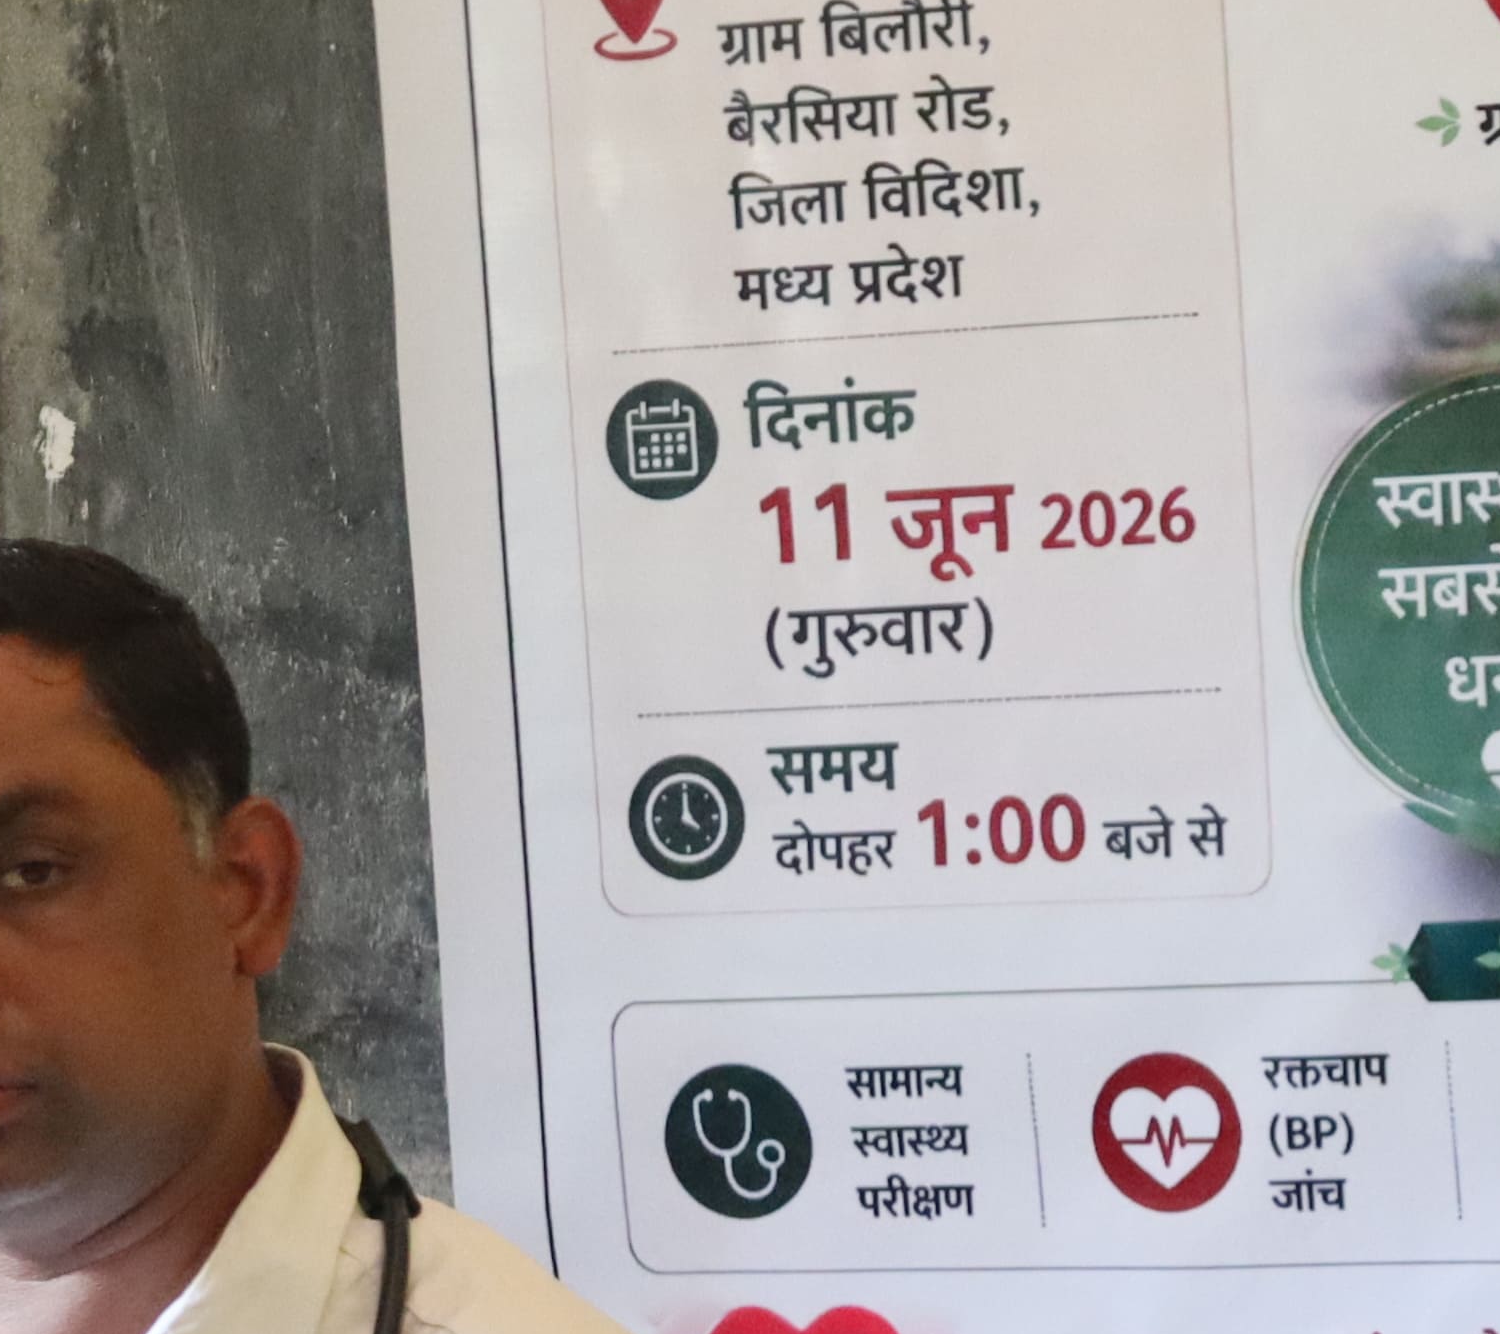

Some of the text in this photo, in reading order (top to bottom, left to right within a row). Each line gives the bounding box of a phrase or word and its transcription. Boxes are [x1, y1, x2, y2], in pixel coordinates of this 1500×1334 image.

[717, 19, 803, 65] ग्राम
[724, 74, 1009, 145] बैरसिया रोड,
[728, 158, 1039, 230] जिला विदिशा,
[734, 243, 964, 310] मध्य प्रदेश
[743, 377, 916, 450] दिनांक
[760, 484, 1195, 581] 11 जून 2026
[766, 597, 993, 678] (गुरुवार)
[766, 743, 898, 795] समय
[773, 794, 1227, 875] दोपहर 1:00 बजे से
[845, 1065, 962, 1099] सामान्य
[1262, 1054, 1389, 1088] रक्तचाप
[851, 1125, 968, 1157] स्वास्थ्य
[1270, 1113, 1354, 1157] (BP)
[857, 1174, 974, 1220] परीक्षण
[1269, 1169, 1346, 1211] जांच
